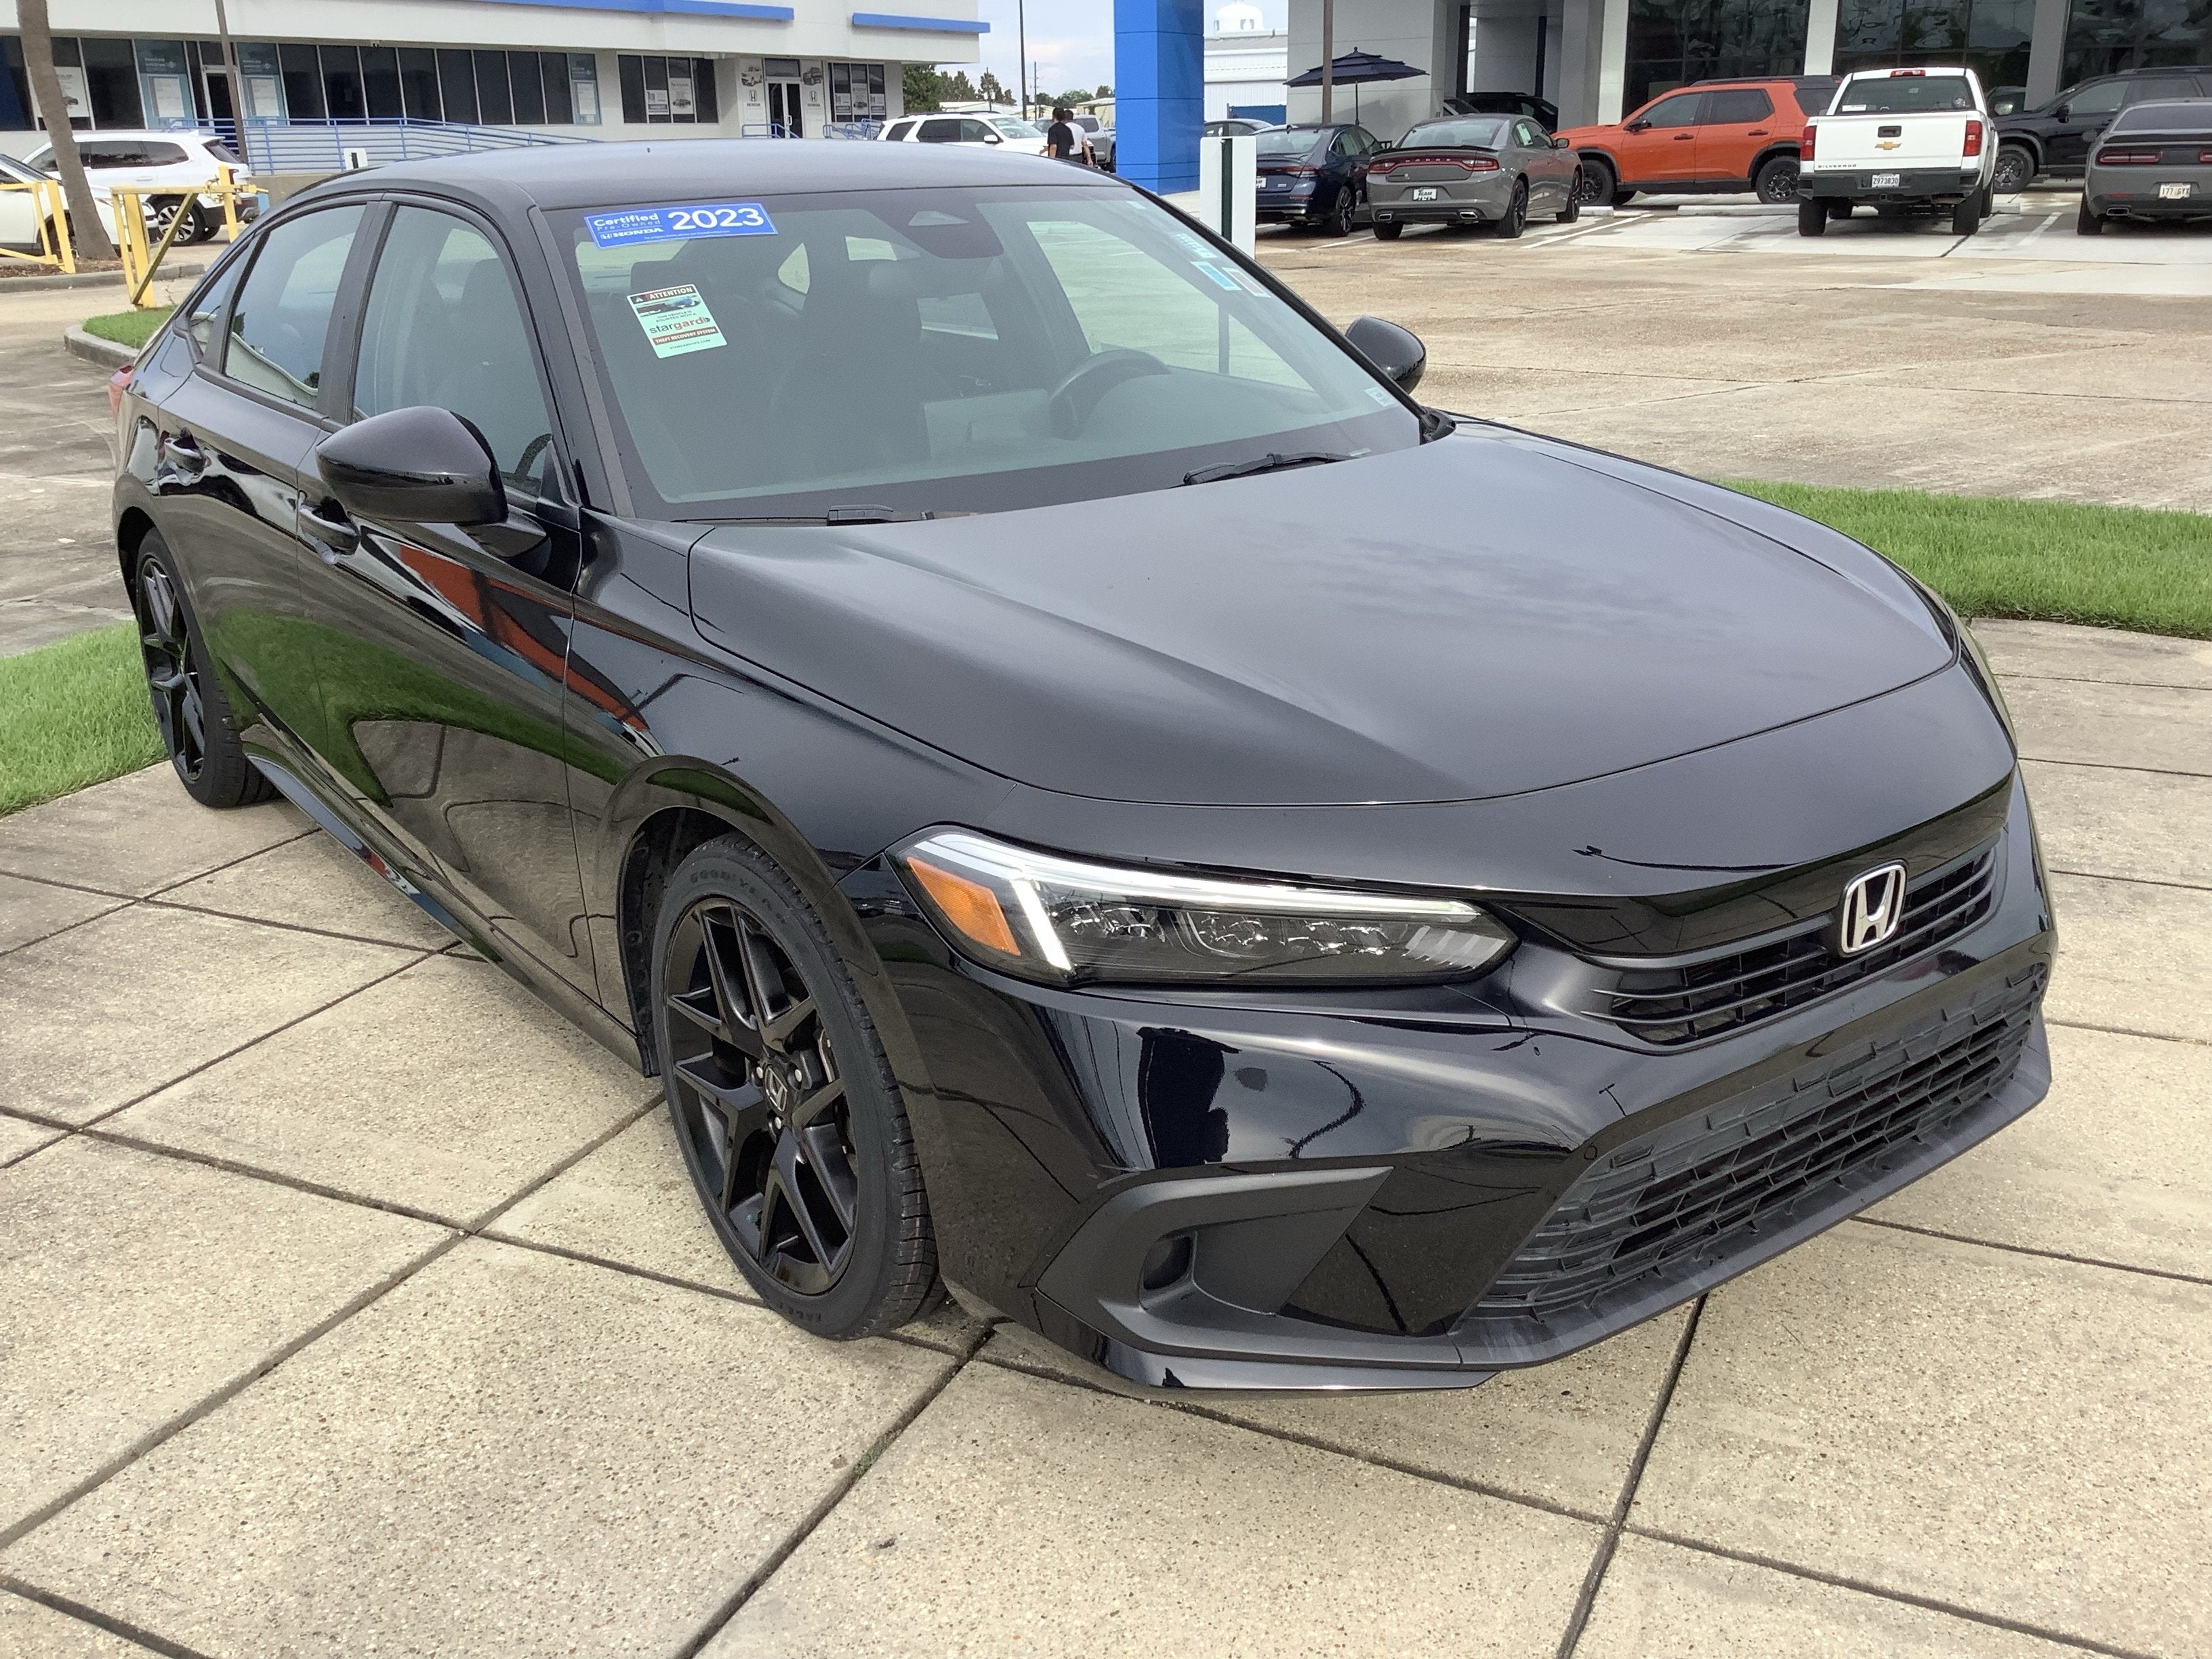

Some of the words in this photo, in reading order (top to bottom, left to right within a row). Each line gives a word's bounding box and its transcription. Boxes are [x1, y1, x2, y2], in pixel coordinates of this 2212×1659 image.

[594, 213, 659, 226] Certified
[667, 207, 764, 230] 2023
[597, 220, 661, 231] Pre-Owned
[613, 228, 664, 238] HONDA
[650, 287, 693, 300] ATTENTION
[670, 331, 696, 341] RECOVERY
